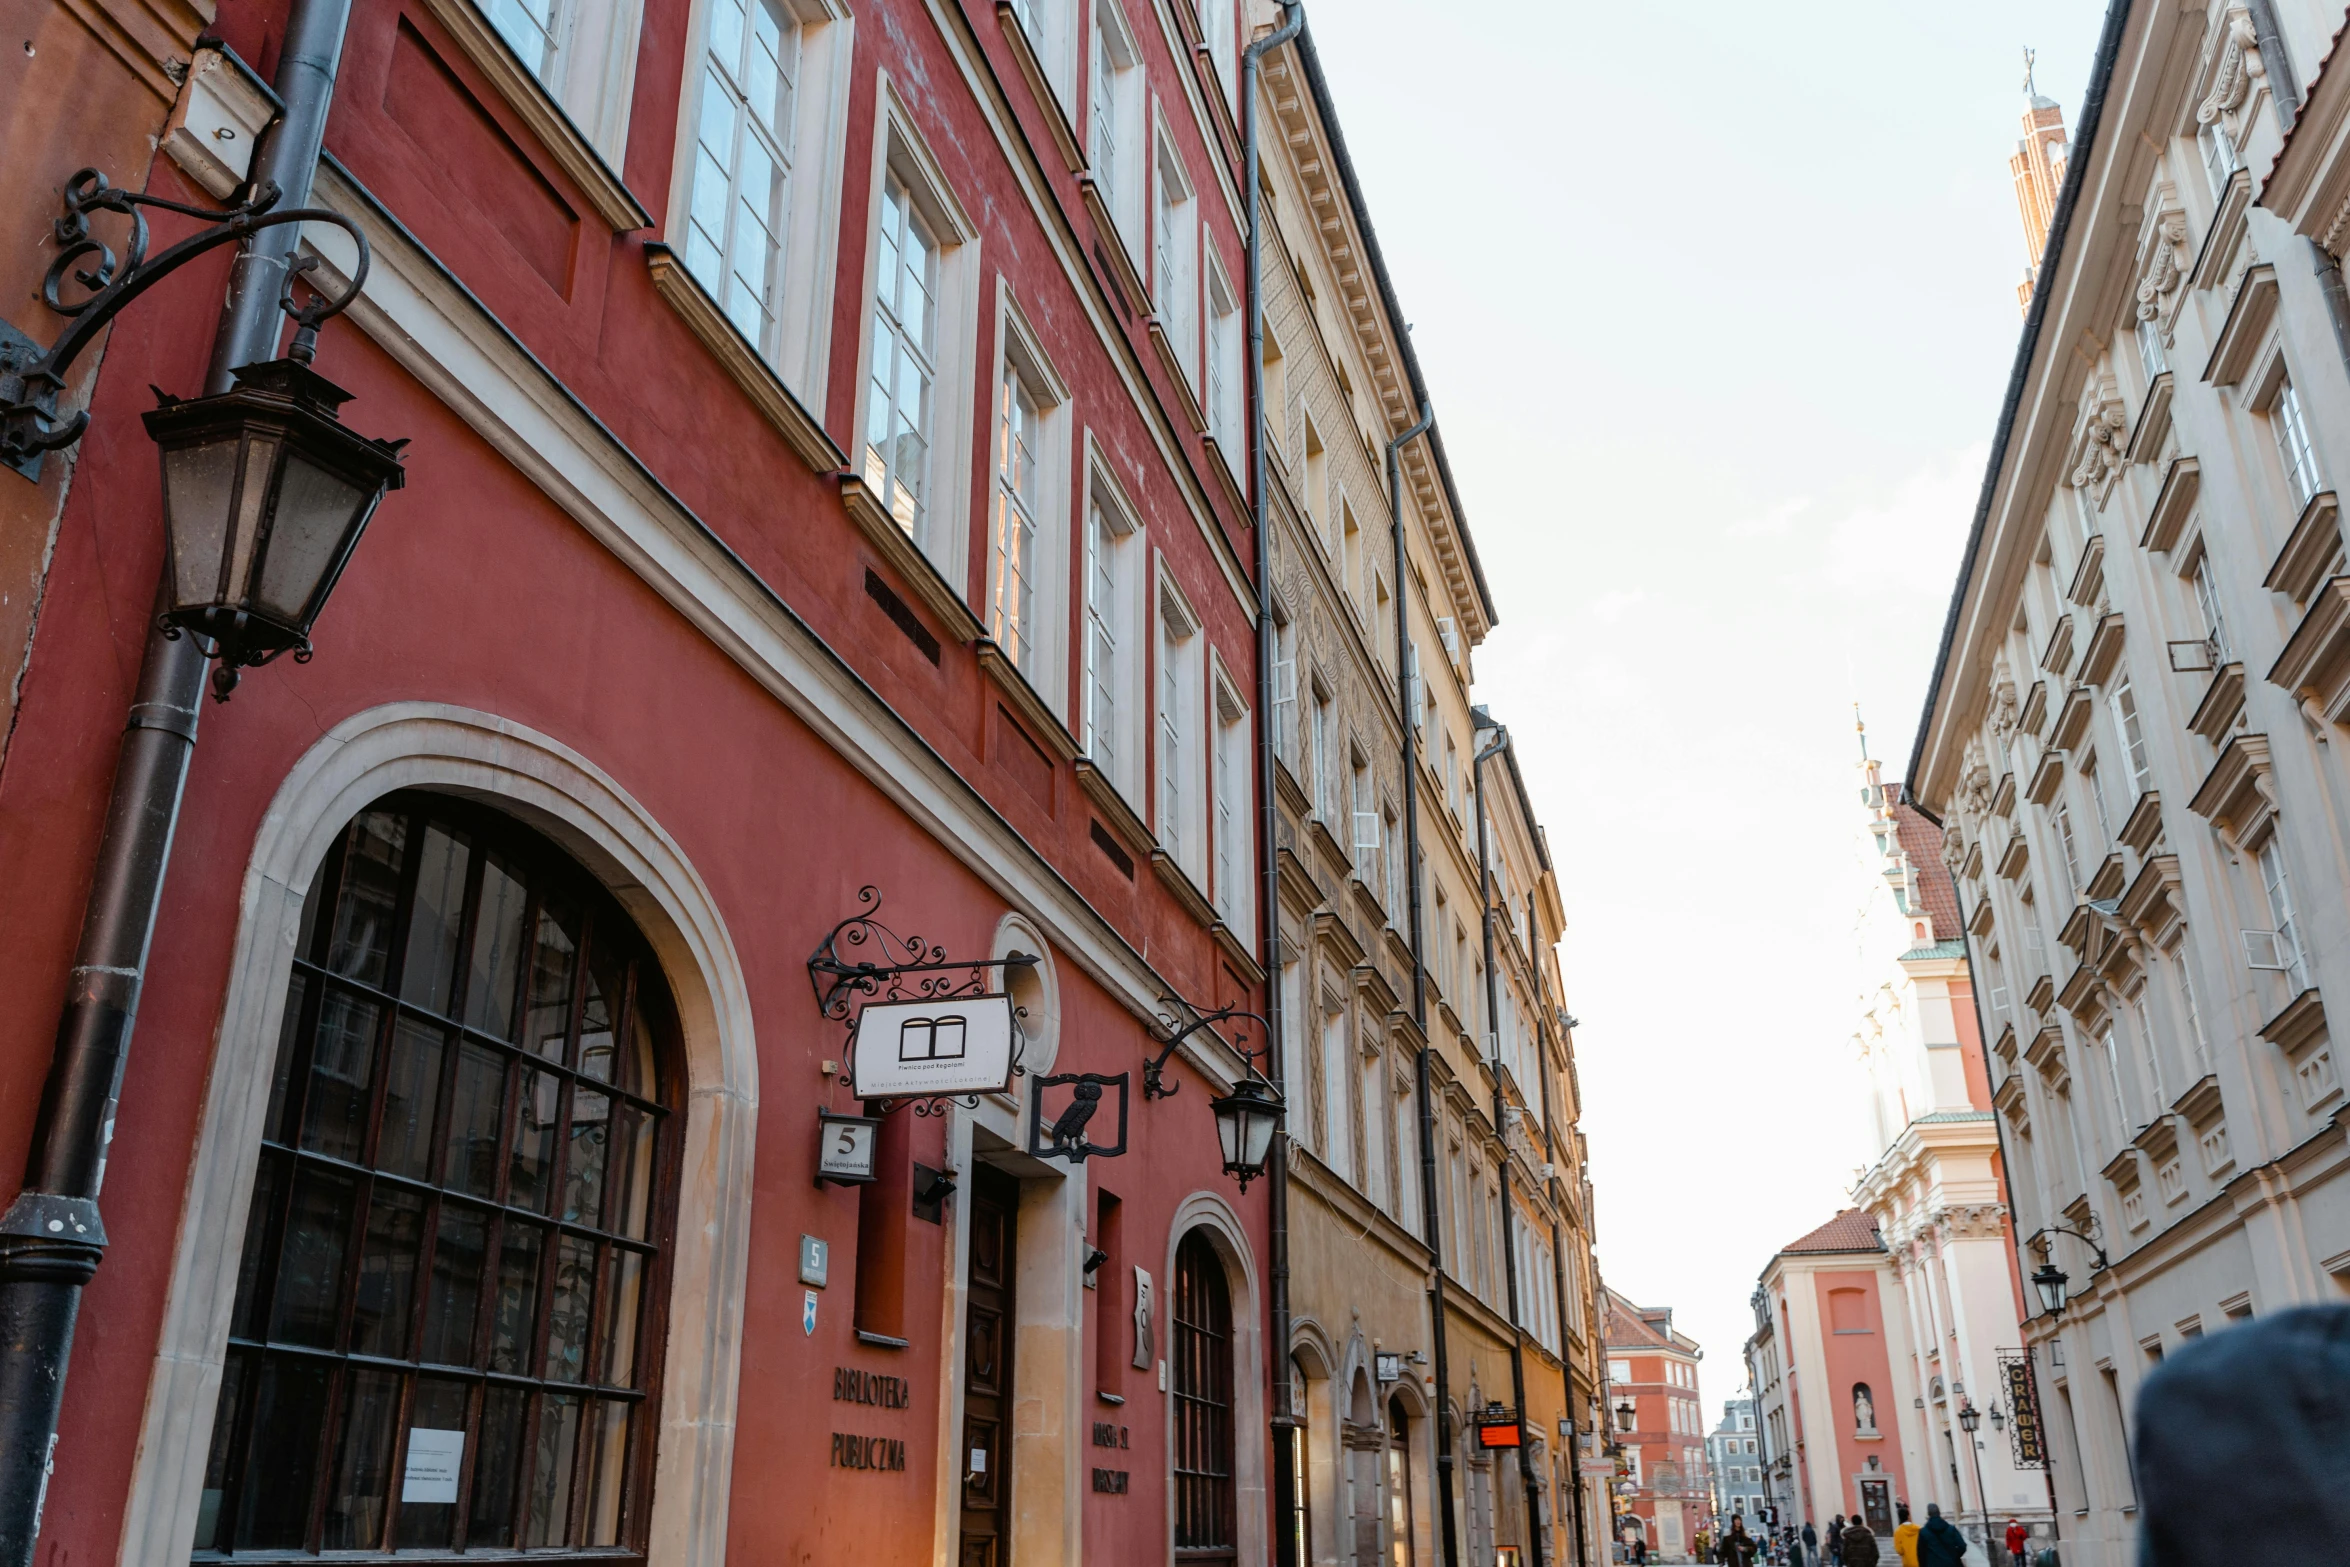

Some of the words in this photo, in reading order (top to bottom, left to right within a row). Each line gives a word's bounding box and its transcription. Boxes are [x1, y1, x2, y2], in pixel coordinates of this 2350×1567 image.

[870, 1080, 903, 1089] Miejsce
[954, 1075, 992, 1083] Lokalnej
[837, 1126, 856, 1155] 5
[823, 1159, 869, 1169] Świętojańska
[811, 1243, 820, 1267] 5
[1385, 1356, 1391, 1369] 7
[833, 1366, 909, 1410] BIBLIOTEKA
[830, 1431, 905, 1472] PUBLICZNA
